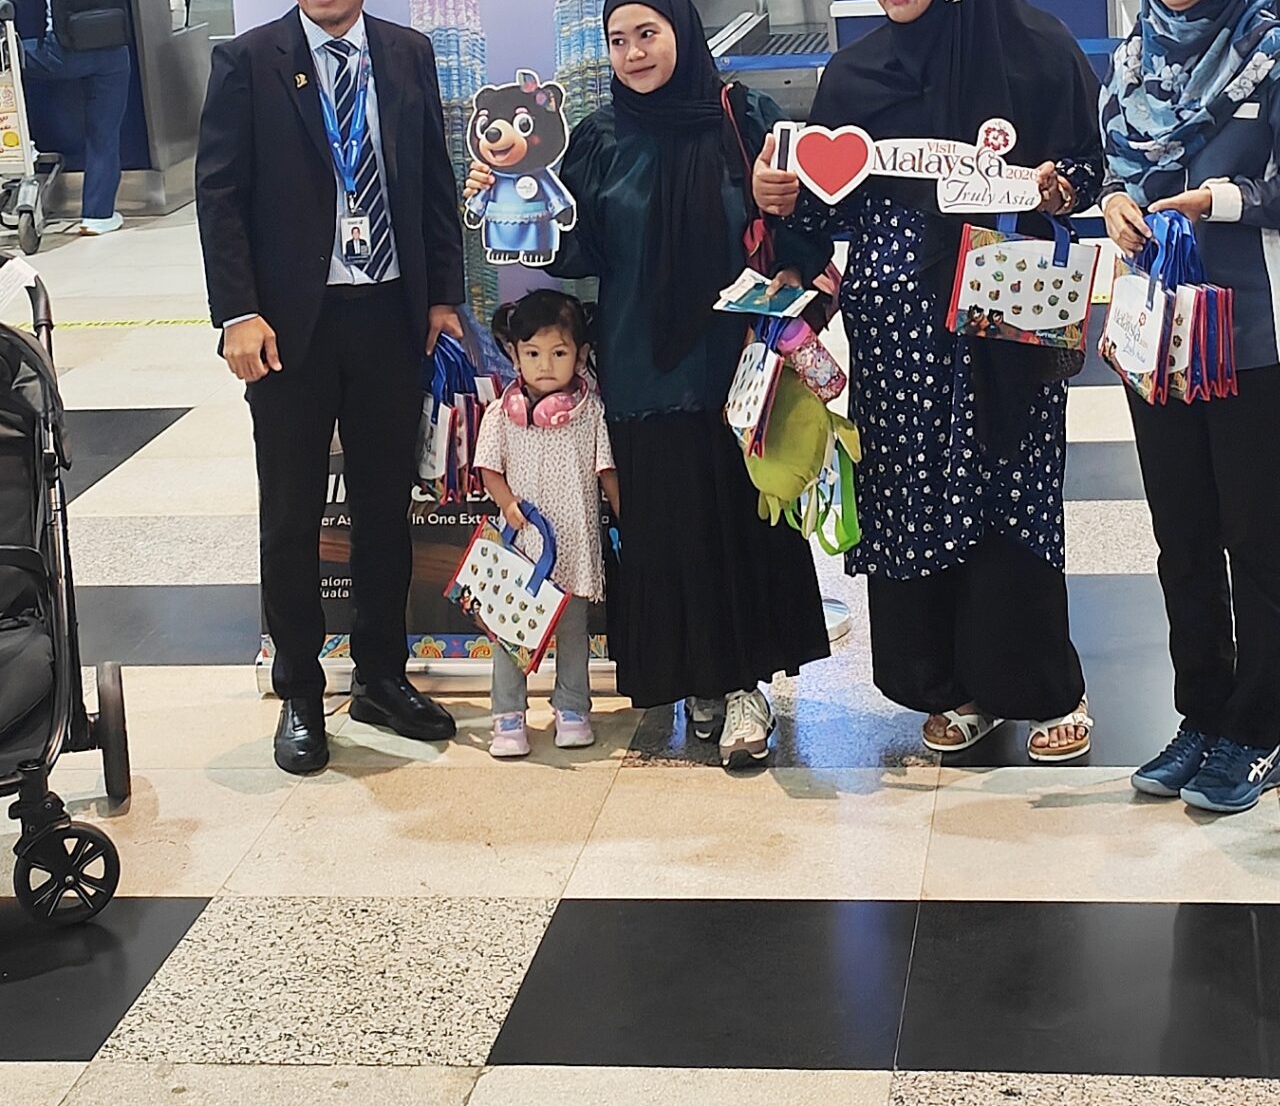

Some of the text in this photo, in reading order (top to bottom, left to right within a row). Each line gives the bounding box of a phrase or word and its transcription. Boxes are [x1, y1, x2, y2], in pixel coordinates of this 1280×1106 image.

[872, 145, 1005, 181] Malaysia
[942, 179, 1035, 208] Truly Asia
[412, 514, 425, 525] In
[427, 514, 457, 525] One
[321, 576, 353, 587] alom
[320, 587, 350, 598] uala
